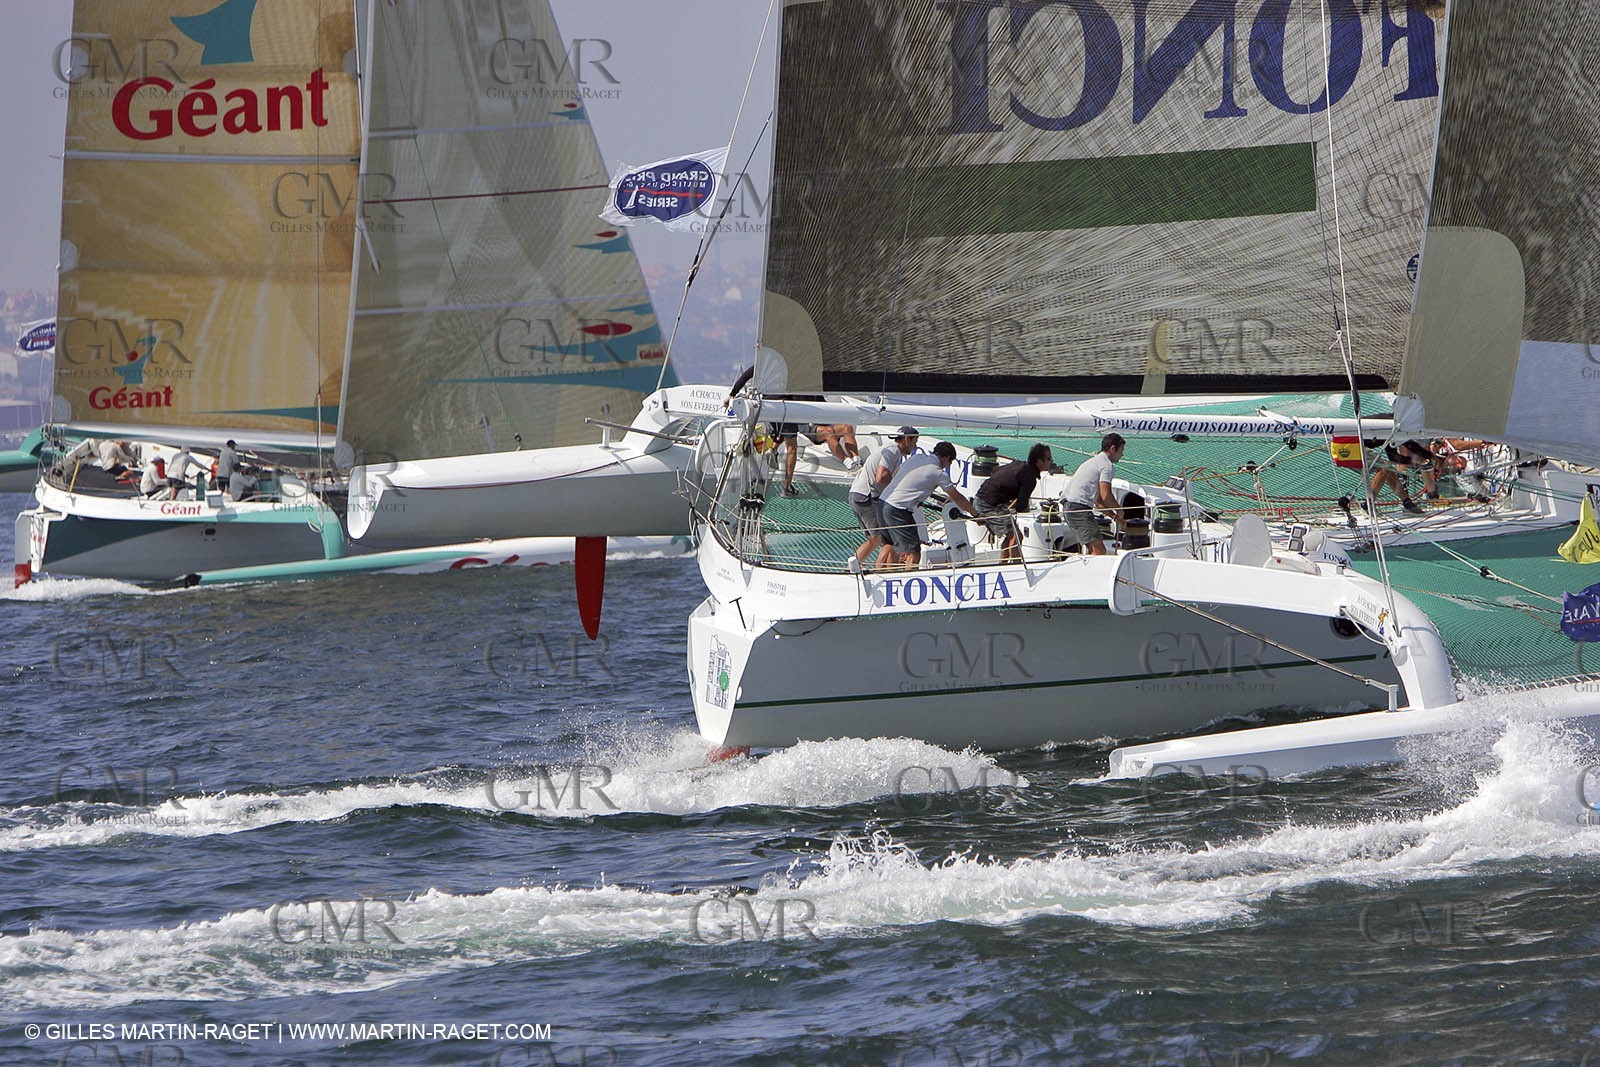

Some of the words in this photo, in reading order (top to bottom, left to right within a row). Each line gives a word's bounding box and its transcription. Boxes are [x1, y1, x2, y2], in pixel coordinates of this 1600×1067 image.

[111, 68, 329, 141] Géant
[89, 384, 173, 411] Géant
[161, 501, 202, 516] Géant
[883, 571, 1012, 609] FONCIA
